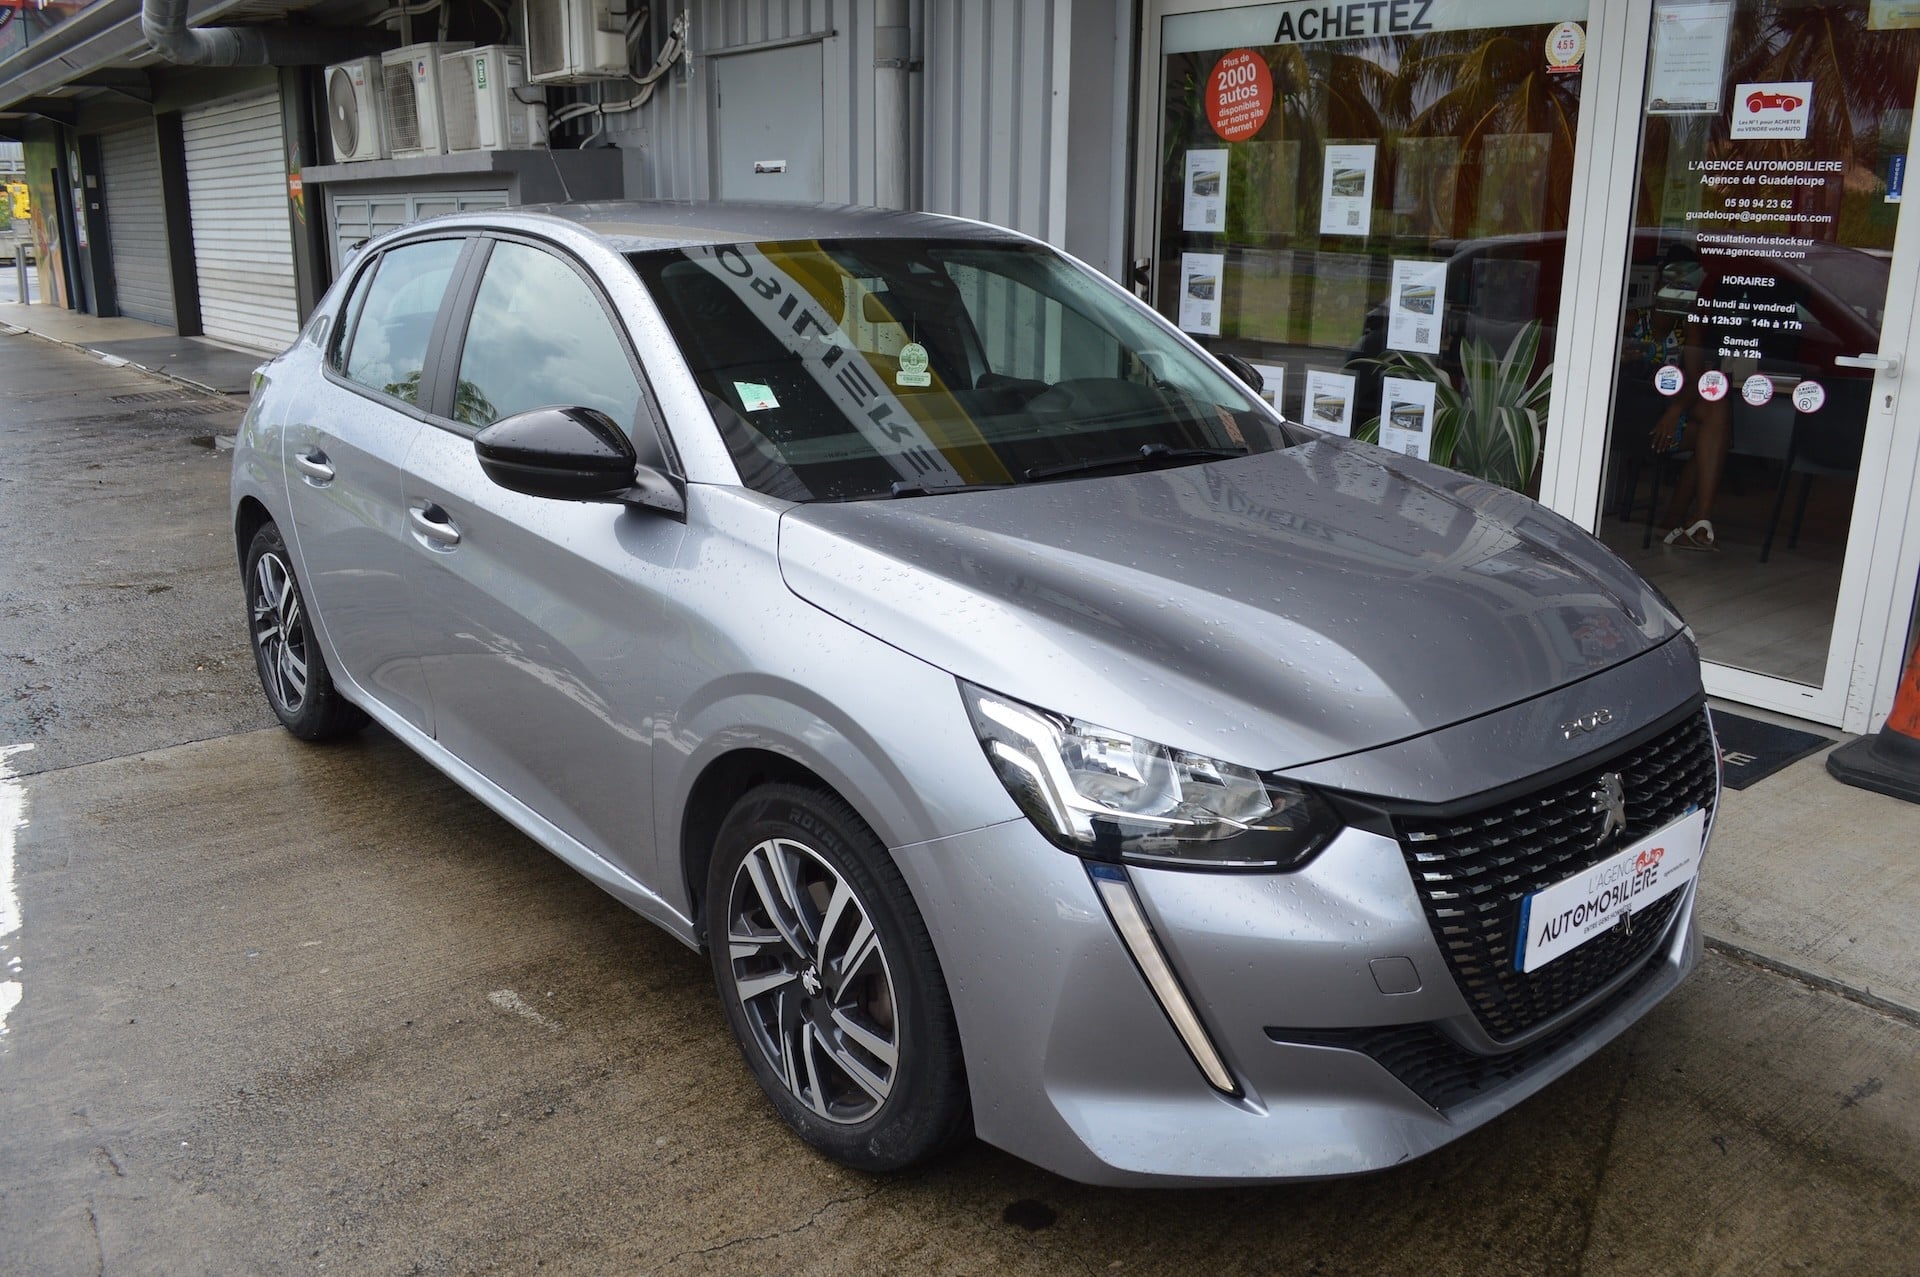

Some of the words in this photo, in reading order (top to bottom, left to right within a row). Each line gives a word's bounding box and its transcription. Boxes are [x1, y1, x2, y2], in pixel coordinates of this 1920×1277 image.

[1274, 0, 1432, 43] ACHETEZ
[1223, 57, 1239, 68] Plus
[1240, 54, 1250, 63] de
[1218, 63, 1257, 91] 2000
[1219, 84, 1258, 105] autos
[1219, 100, 1260, 117] disponibles
[1216, 118, 1229, 128] sur
[1230, 112, 1249, 124] notre
[1250, 108, 1264, 119] site
[1225, 120, 1252, 135] internet
[1688, 160, 1744, 171] L'AGENCE
[1746, 160, 1842, 172] AUTOMOBILIERE
[1700, 174, 1740, 187] Agence
[1742, 174, 1756, 185] de
[1758, 175, 1825, 188] Guadeloupe
[1724, 198, 1737, 208] 05
[1738, 199, 1750, 208] 90
[1752, 199, 1764, 208] 94
[1766, 199, 1778, 209] 23
[1780, 199, 1793, 209] 62
[1685, 210, 1832, 224] guadeloupe@agenceauto.com
[1700, 247, 1806, 259] www.agenceauto.com
[1722, 275, 1776, 287] HORAIRES
[1697, 298, 1711, 308] Du
[1713, 299, 1737, 309] lundi
[1738, 301, 1751, 310] au
[1753, 302, 1796, 313] vendredi
[1687, 314, 1699, 323] 9h
[1702, 315, 1709, 323] à
[1711, 316, 1742, 326] 12h30
[1751, 318, 1770, 328] 14h
[1773, 319, 1779, 329] à
[1782, 320, 1802, 330] 17h
[1723, 336, 1759, 347] Samedi
[1718, 348, 1731, 357] 9h
[1733, 348, 1740, 357] à
[1743, 349, 1762, 359] 12h
[1560, 709, 1612, 740] 208
[1588, 854, 1638, 894] L'AGENCE
